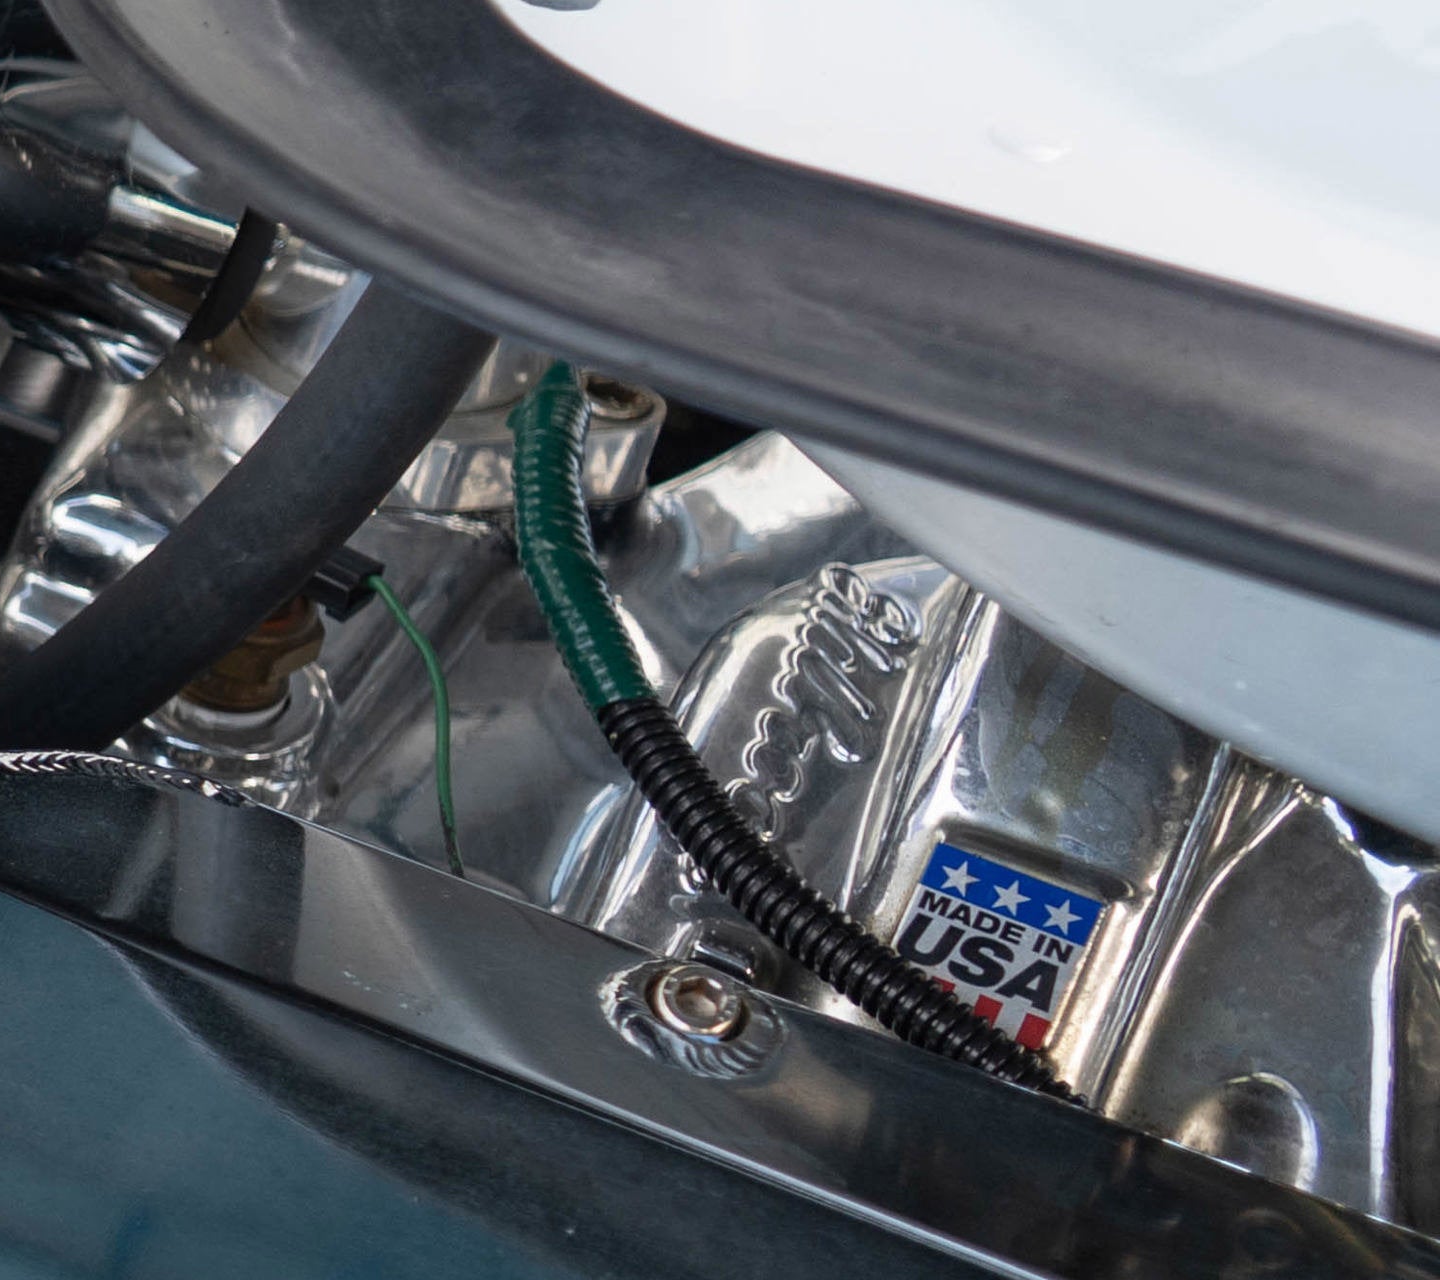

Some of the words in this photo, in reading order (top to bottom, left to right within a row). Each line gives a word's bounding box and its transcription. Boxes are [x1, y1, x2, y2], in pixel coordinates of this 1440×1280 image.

[894, 916, 1061, 1013] USA
[916, 890, 1025, 948] MADE
[1031, 924, 1074, 966] IN
